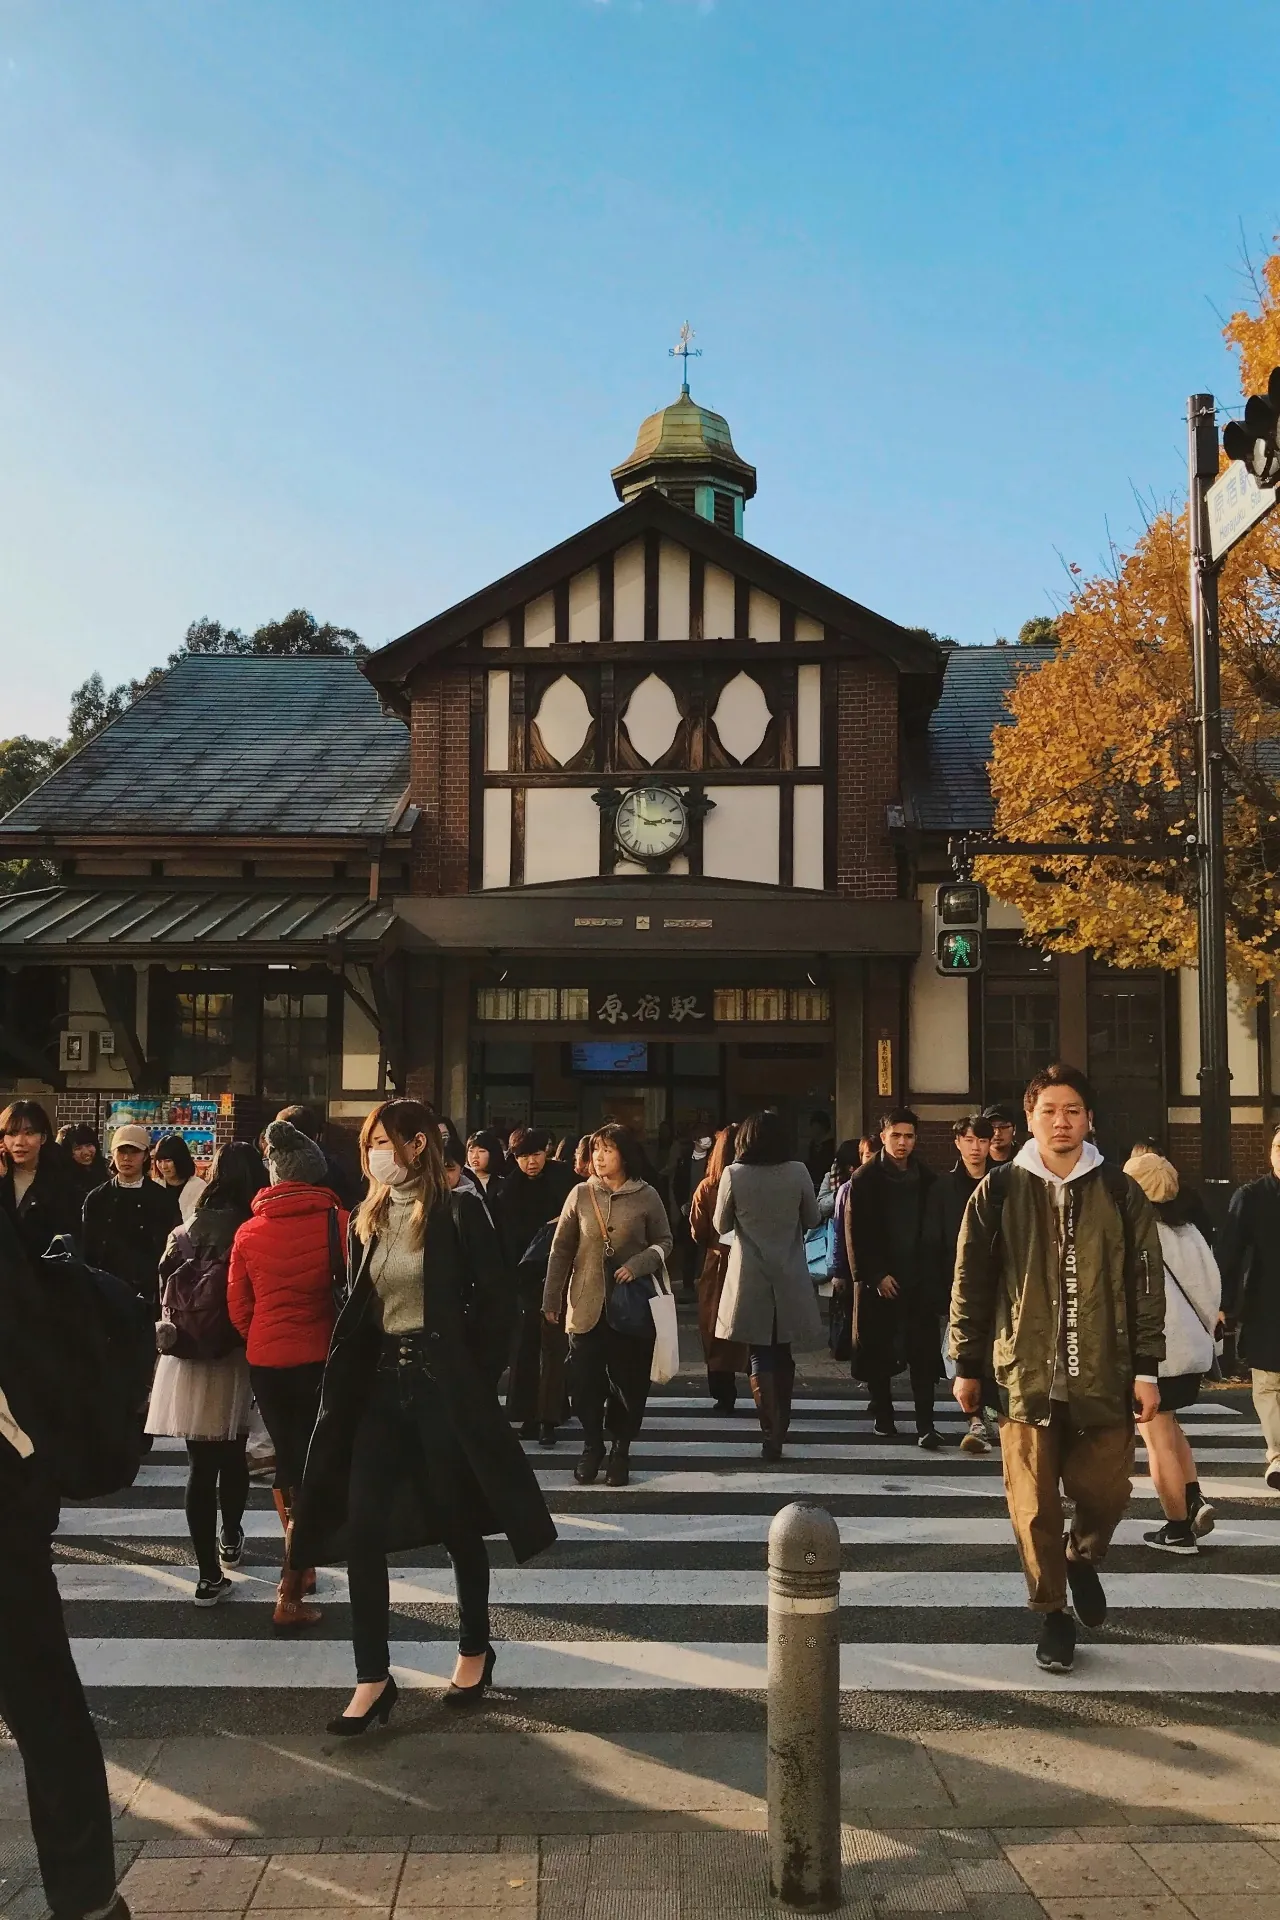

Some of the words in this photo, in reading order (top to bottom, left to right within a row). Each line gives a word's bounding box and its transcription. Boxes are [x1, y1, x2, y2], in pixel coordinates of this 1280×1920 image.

[597, 993, 706, 1024] 原宿駅
[1065, 1244, 1077, 1274] NOT
[1066, 1277, 1078, 1294] IN
[1066, 1297, 1079, 1327] THE
[1066, 1331, 1080, 1377] MOOD
